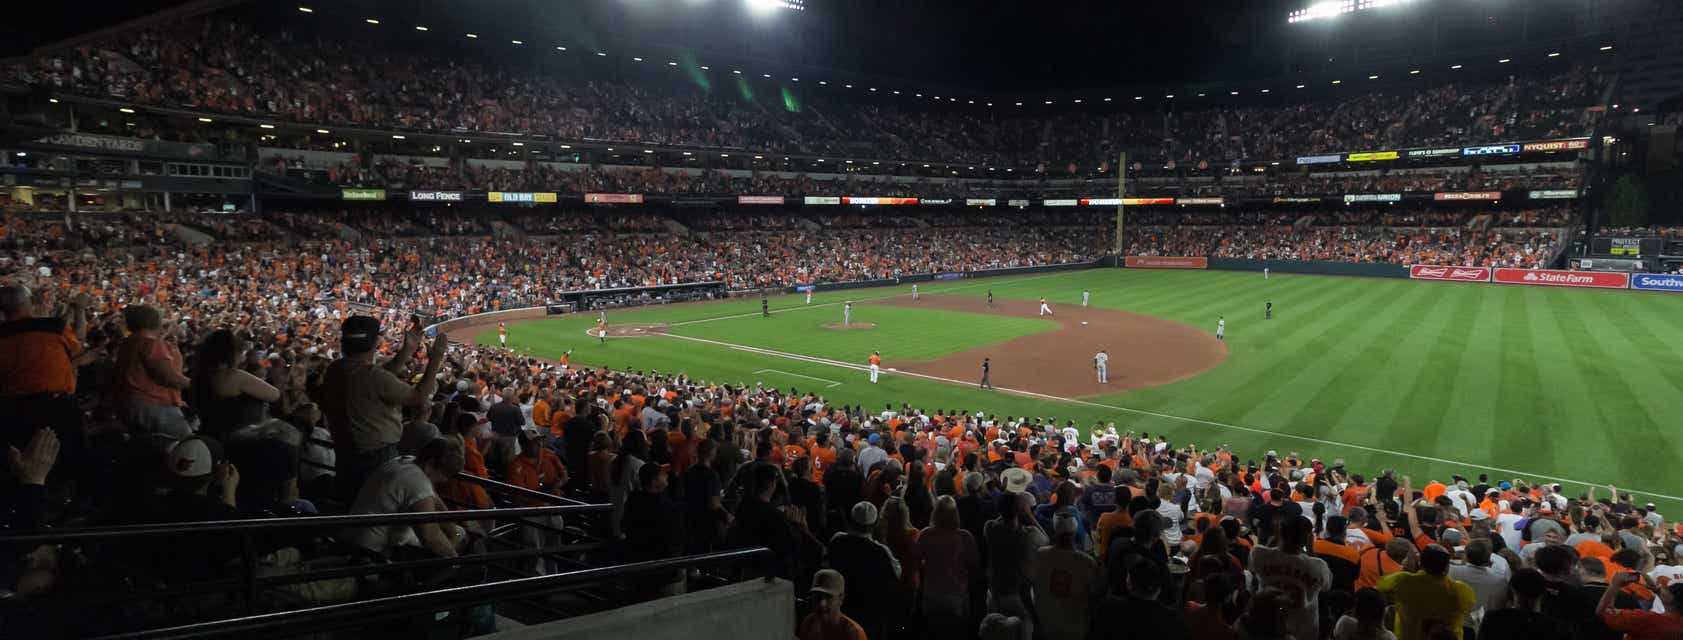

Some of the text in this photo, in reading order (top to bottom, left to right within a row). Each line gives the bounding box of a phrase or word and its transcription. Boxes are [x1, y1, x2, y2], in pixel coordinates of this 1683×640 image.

[1524, 142, 1565, 152] NYQUIST
[412, 191, 461, 200] LONG FENCE
[1539, 273, 1593, 284] State Farm
[815, 456, 821, 469] 6
